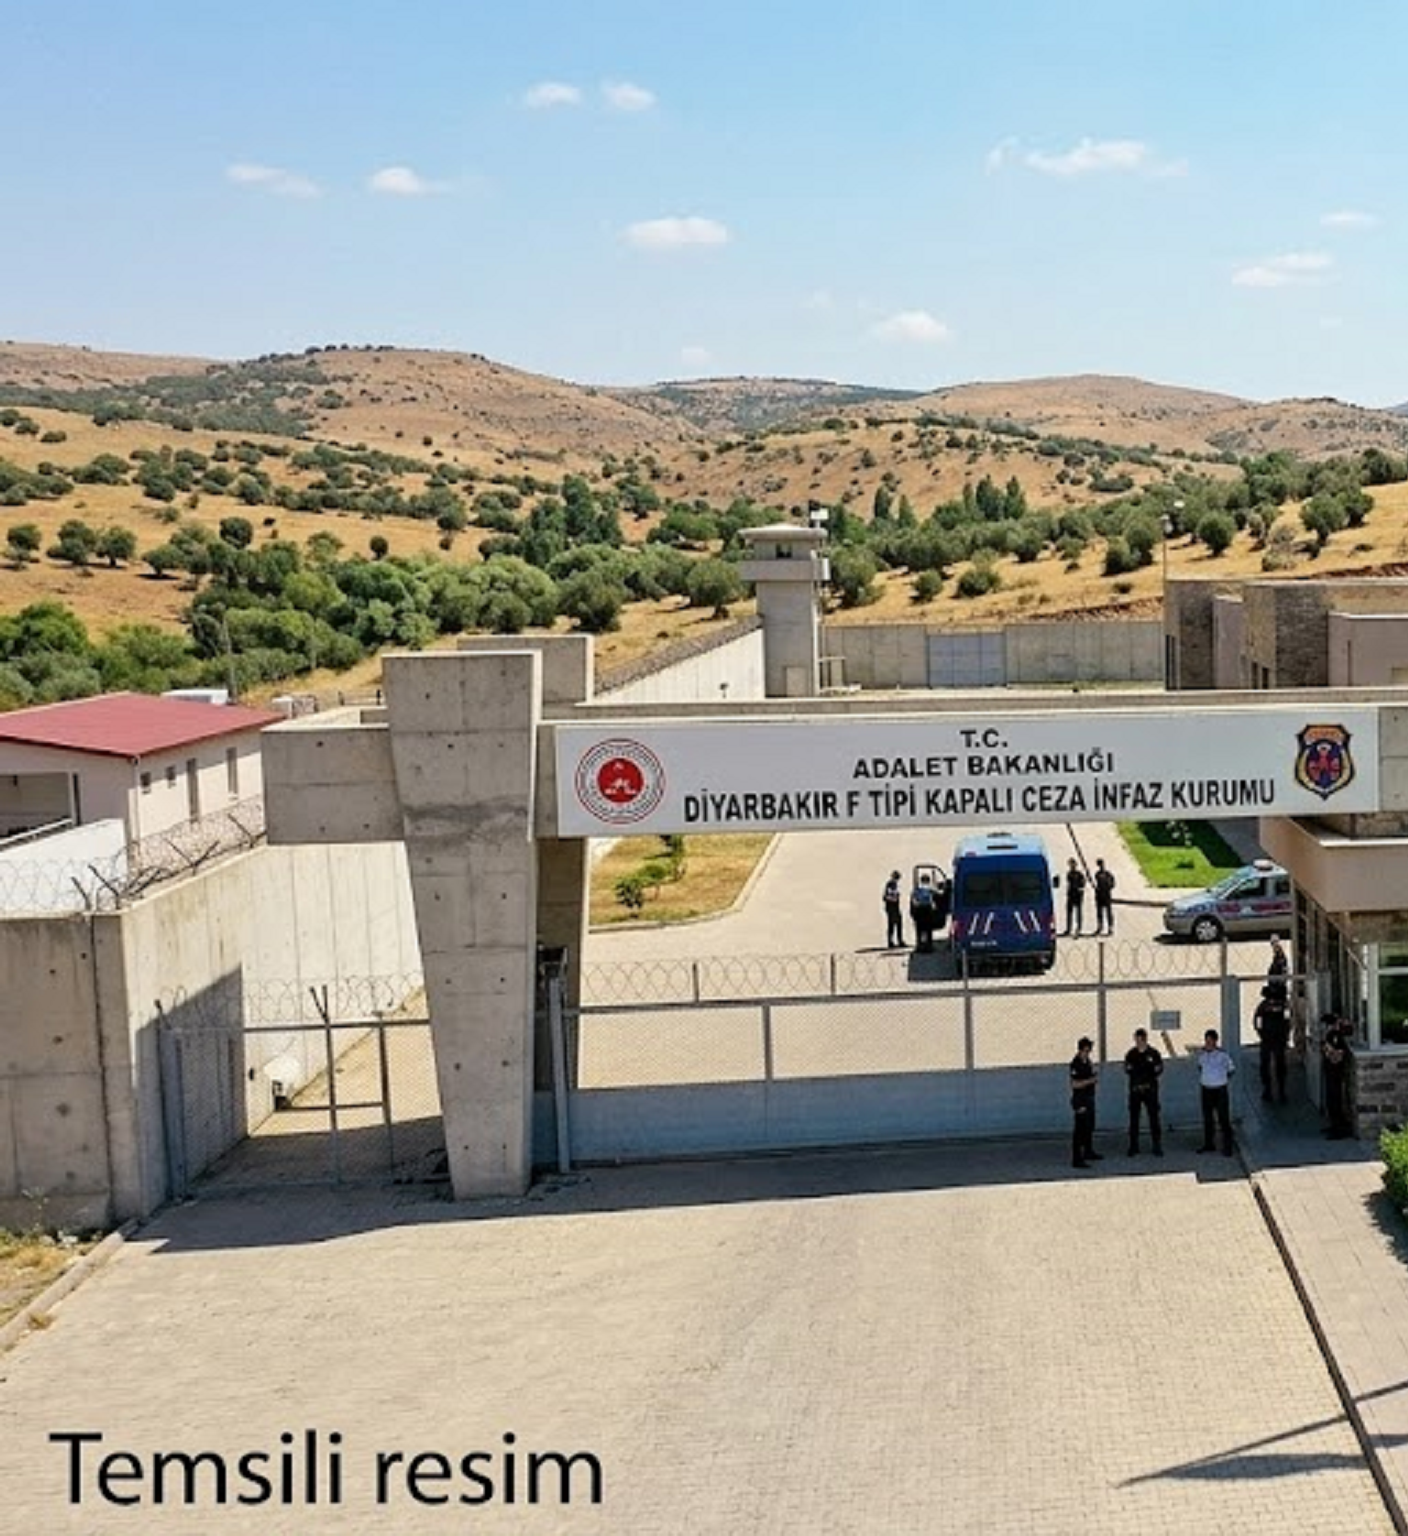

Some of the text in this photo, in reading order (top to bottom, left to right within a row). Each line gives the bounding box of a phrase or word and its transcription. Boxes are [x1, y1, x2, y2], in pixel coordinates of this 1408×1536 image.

[960, 728, 1008, 748] T.C.
[853, 747, 1114, 779] ADALET BAKANLIĞI
[684, 777, 1276, 823] DİYARBAKIR F TİPİ KAPALI CEZA İNFAZ KURUMU
